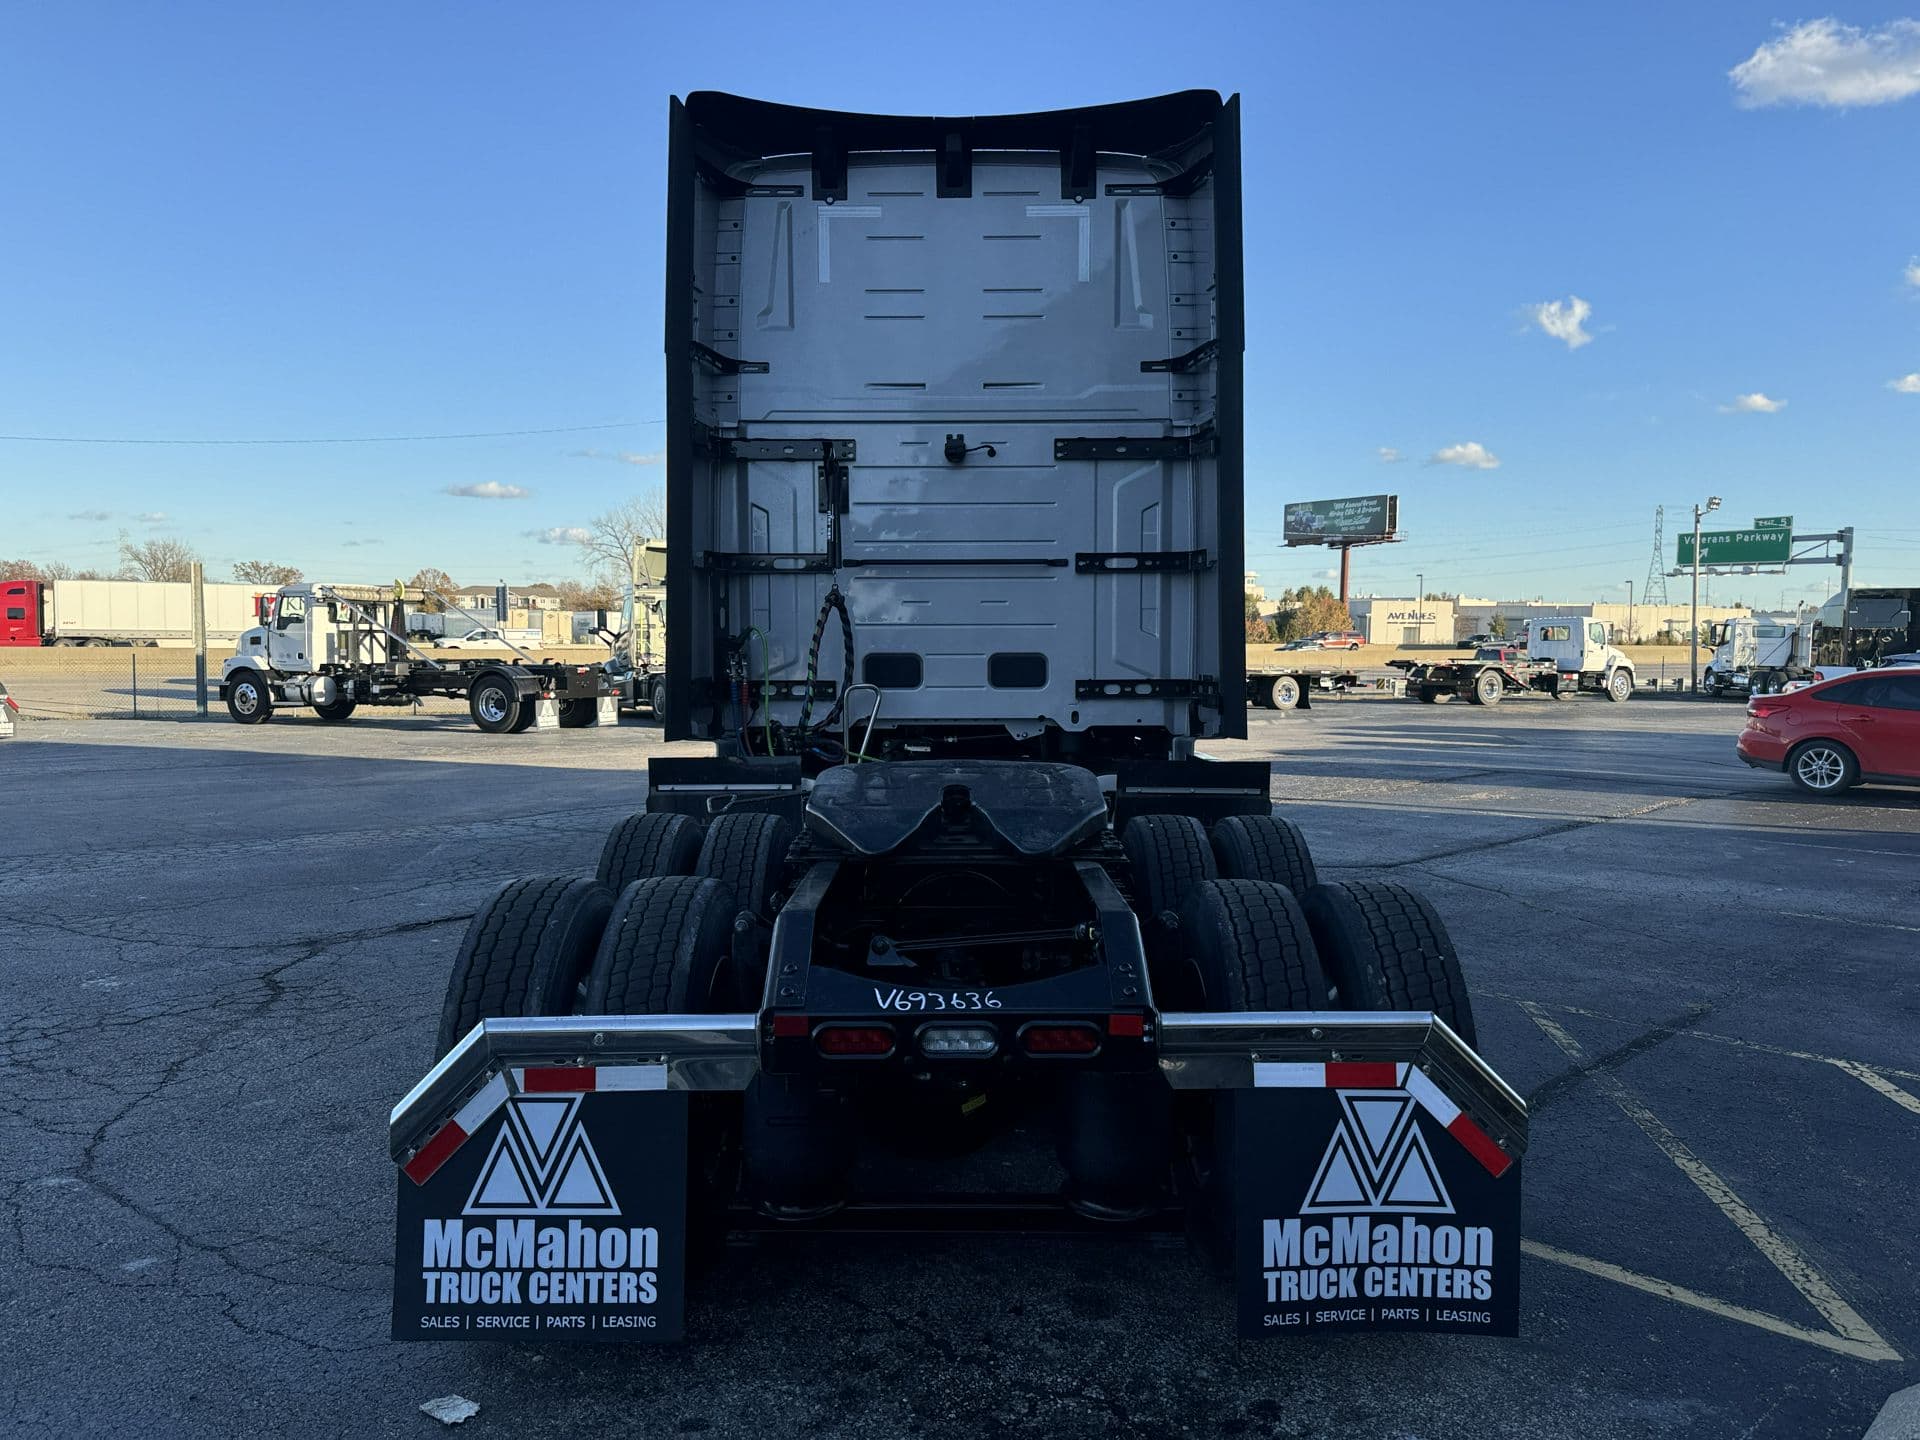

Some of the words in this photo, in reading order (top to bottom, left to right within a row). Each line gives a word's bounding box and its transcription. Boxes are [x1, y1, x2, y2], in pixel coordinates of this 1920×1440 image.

[1780, 518, 1787, 527] 5
[1684, 534, 1730, 544] Veerans
[1736, 533, 1784, 542] Parkway
[874, 988, 1002, 1011] V693636
[422, 1219, 658, 1269] McMahon
[1263, 1216, 1493, 1268] McMahon
[422, 1271, 521, 1304] TRUCK
[528, 1271, 658, 1304] CENTERS
[1264, 1268, 1358, 1302] TRUCK
[1364, 1266, 1492, 1301] CENTERS
[421, 1316, 460, 1328] SALES
[476, 1316, 530, 1328] SERVICE
[546, 1316, 585, 1328] PARTS
[602, 1316, 656, 1328] LEASING
[1264, 1313, 1300, 1326] SALES
[1315, 1309, 1366, 1323] SERVICE
[1381, 1309, 1419, 1321] PARTS
[1436, 1309, 1491, 1324] LEASING
